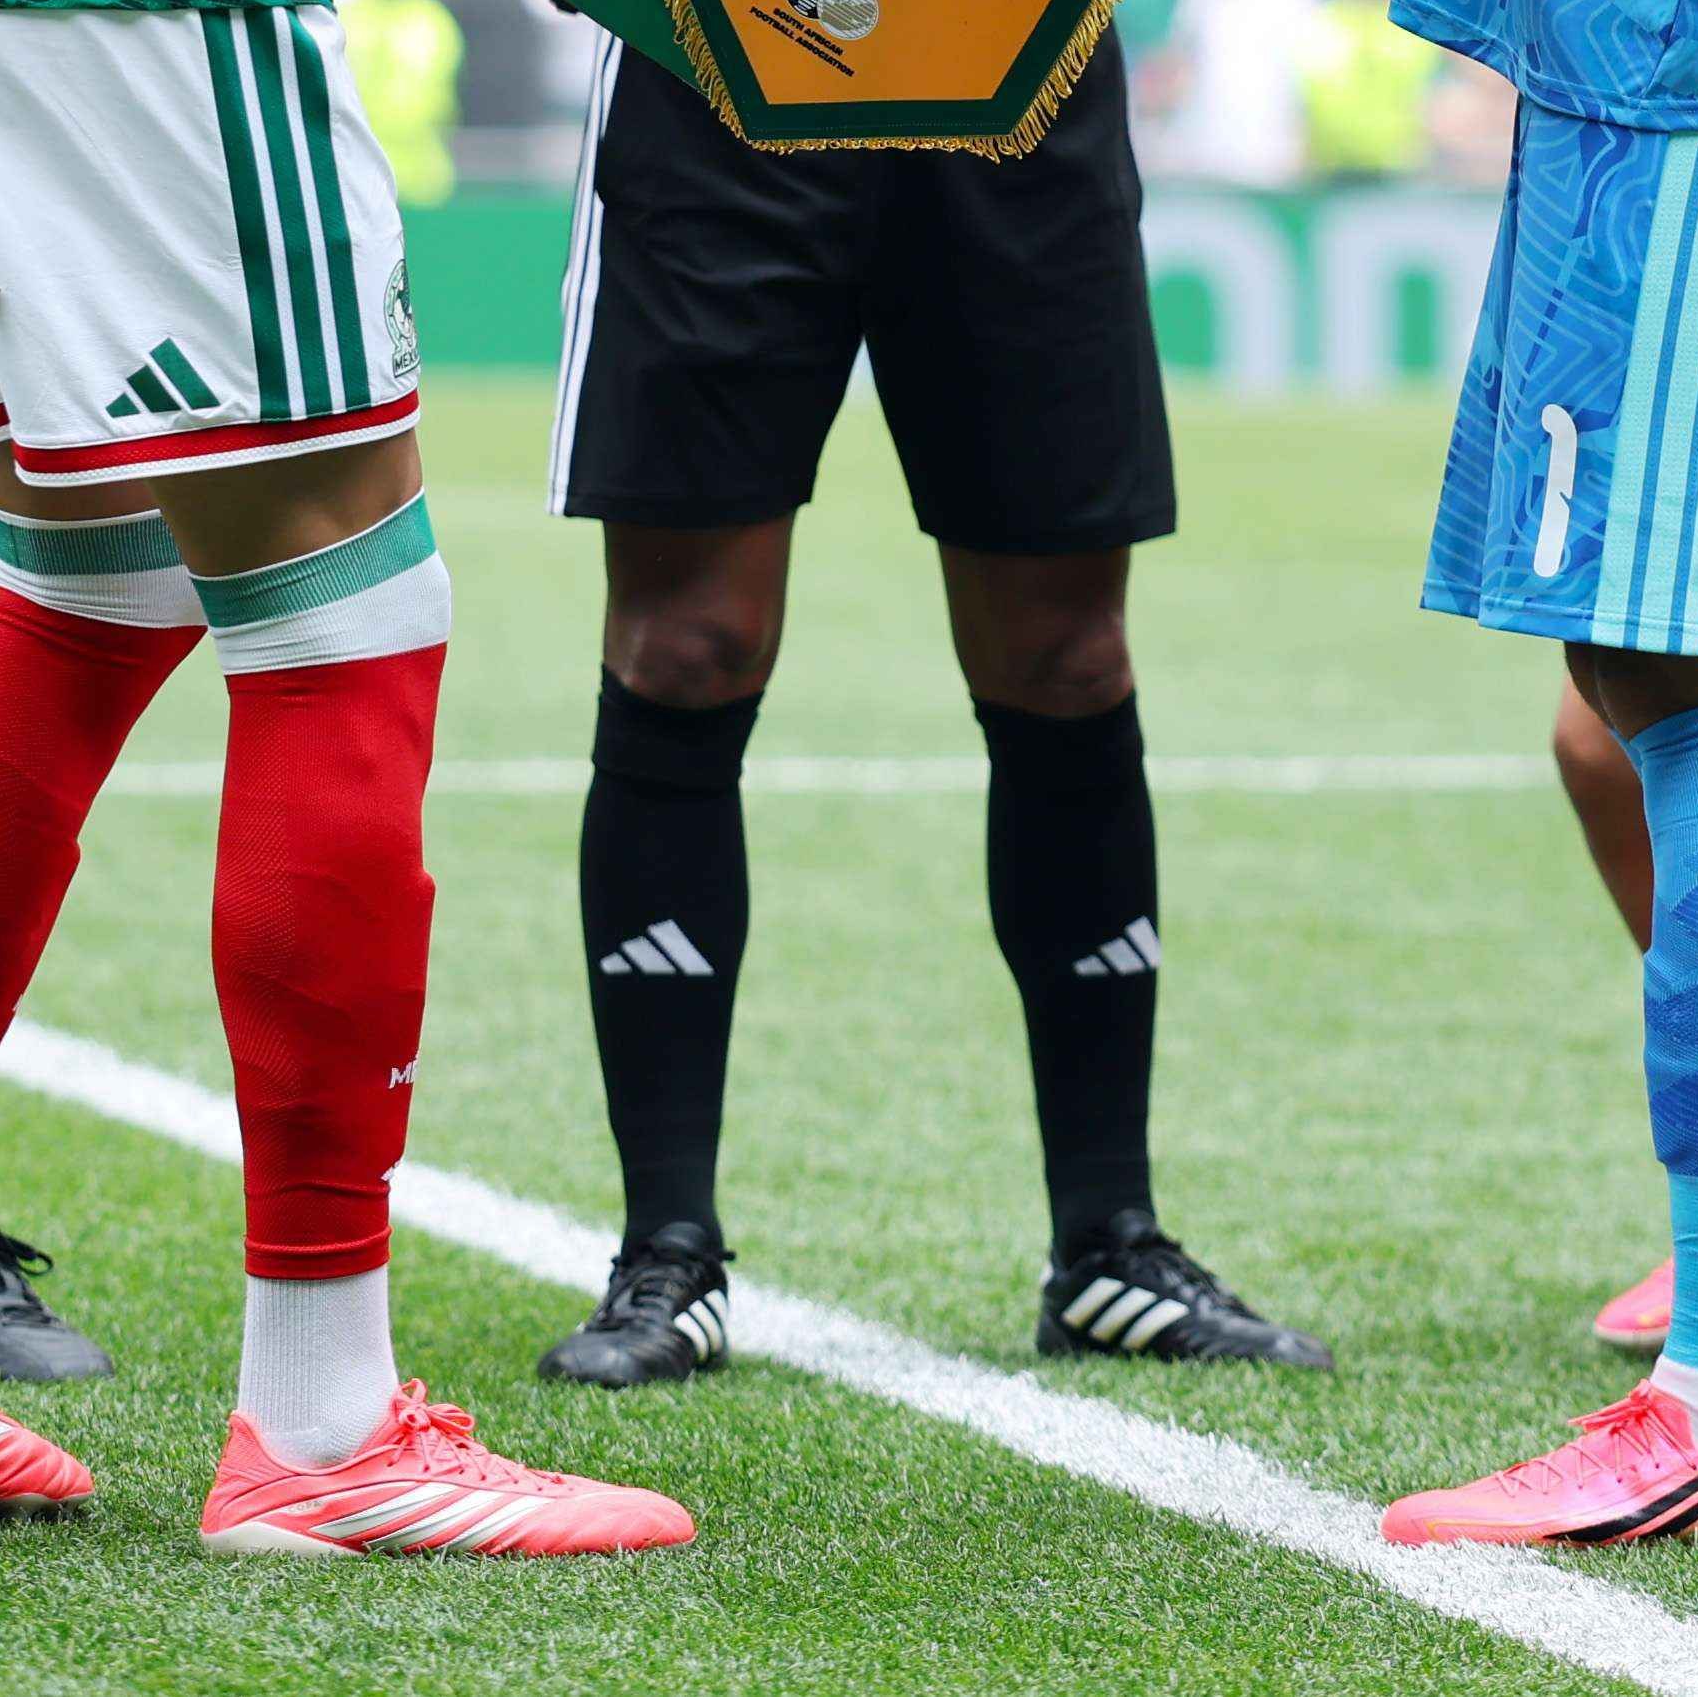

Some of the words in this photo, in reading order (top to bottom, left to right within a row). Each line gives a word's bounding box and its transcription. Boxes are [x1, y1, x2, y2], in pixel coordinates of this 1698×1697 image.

[750, 6, 795, 39] FOOTBALL
[773, 7, 804, 31] SOUTH
[1533, 403, 1578, 578] 1
